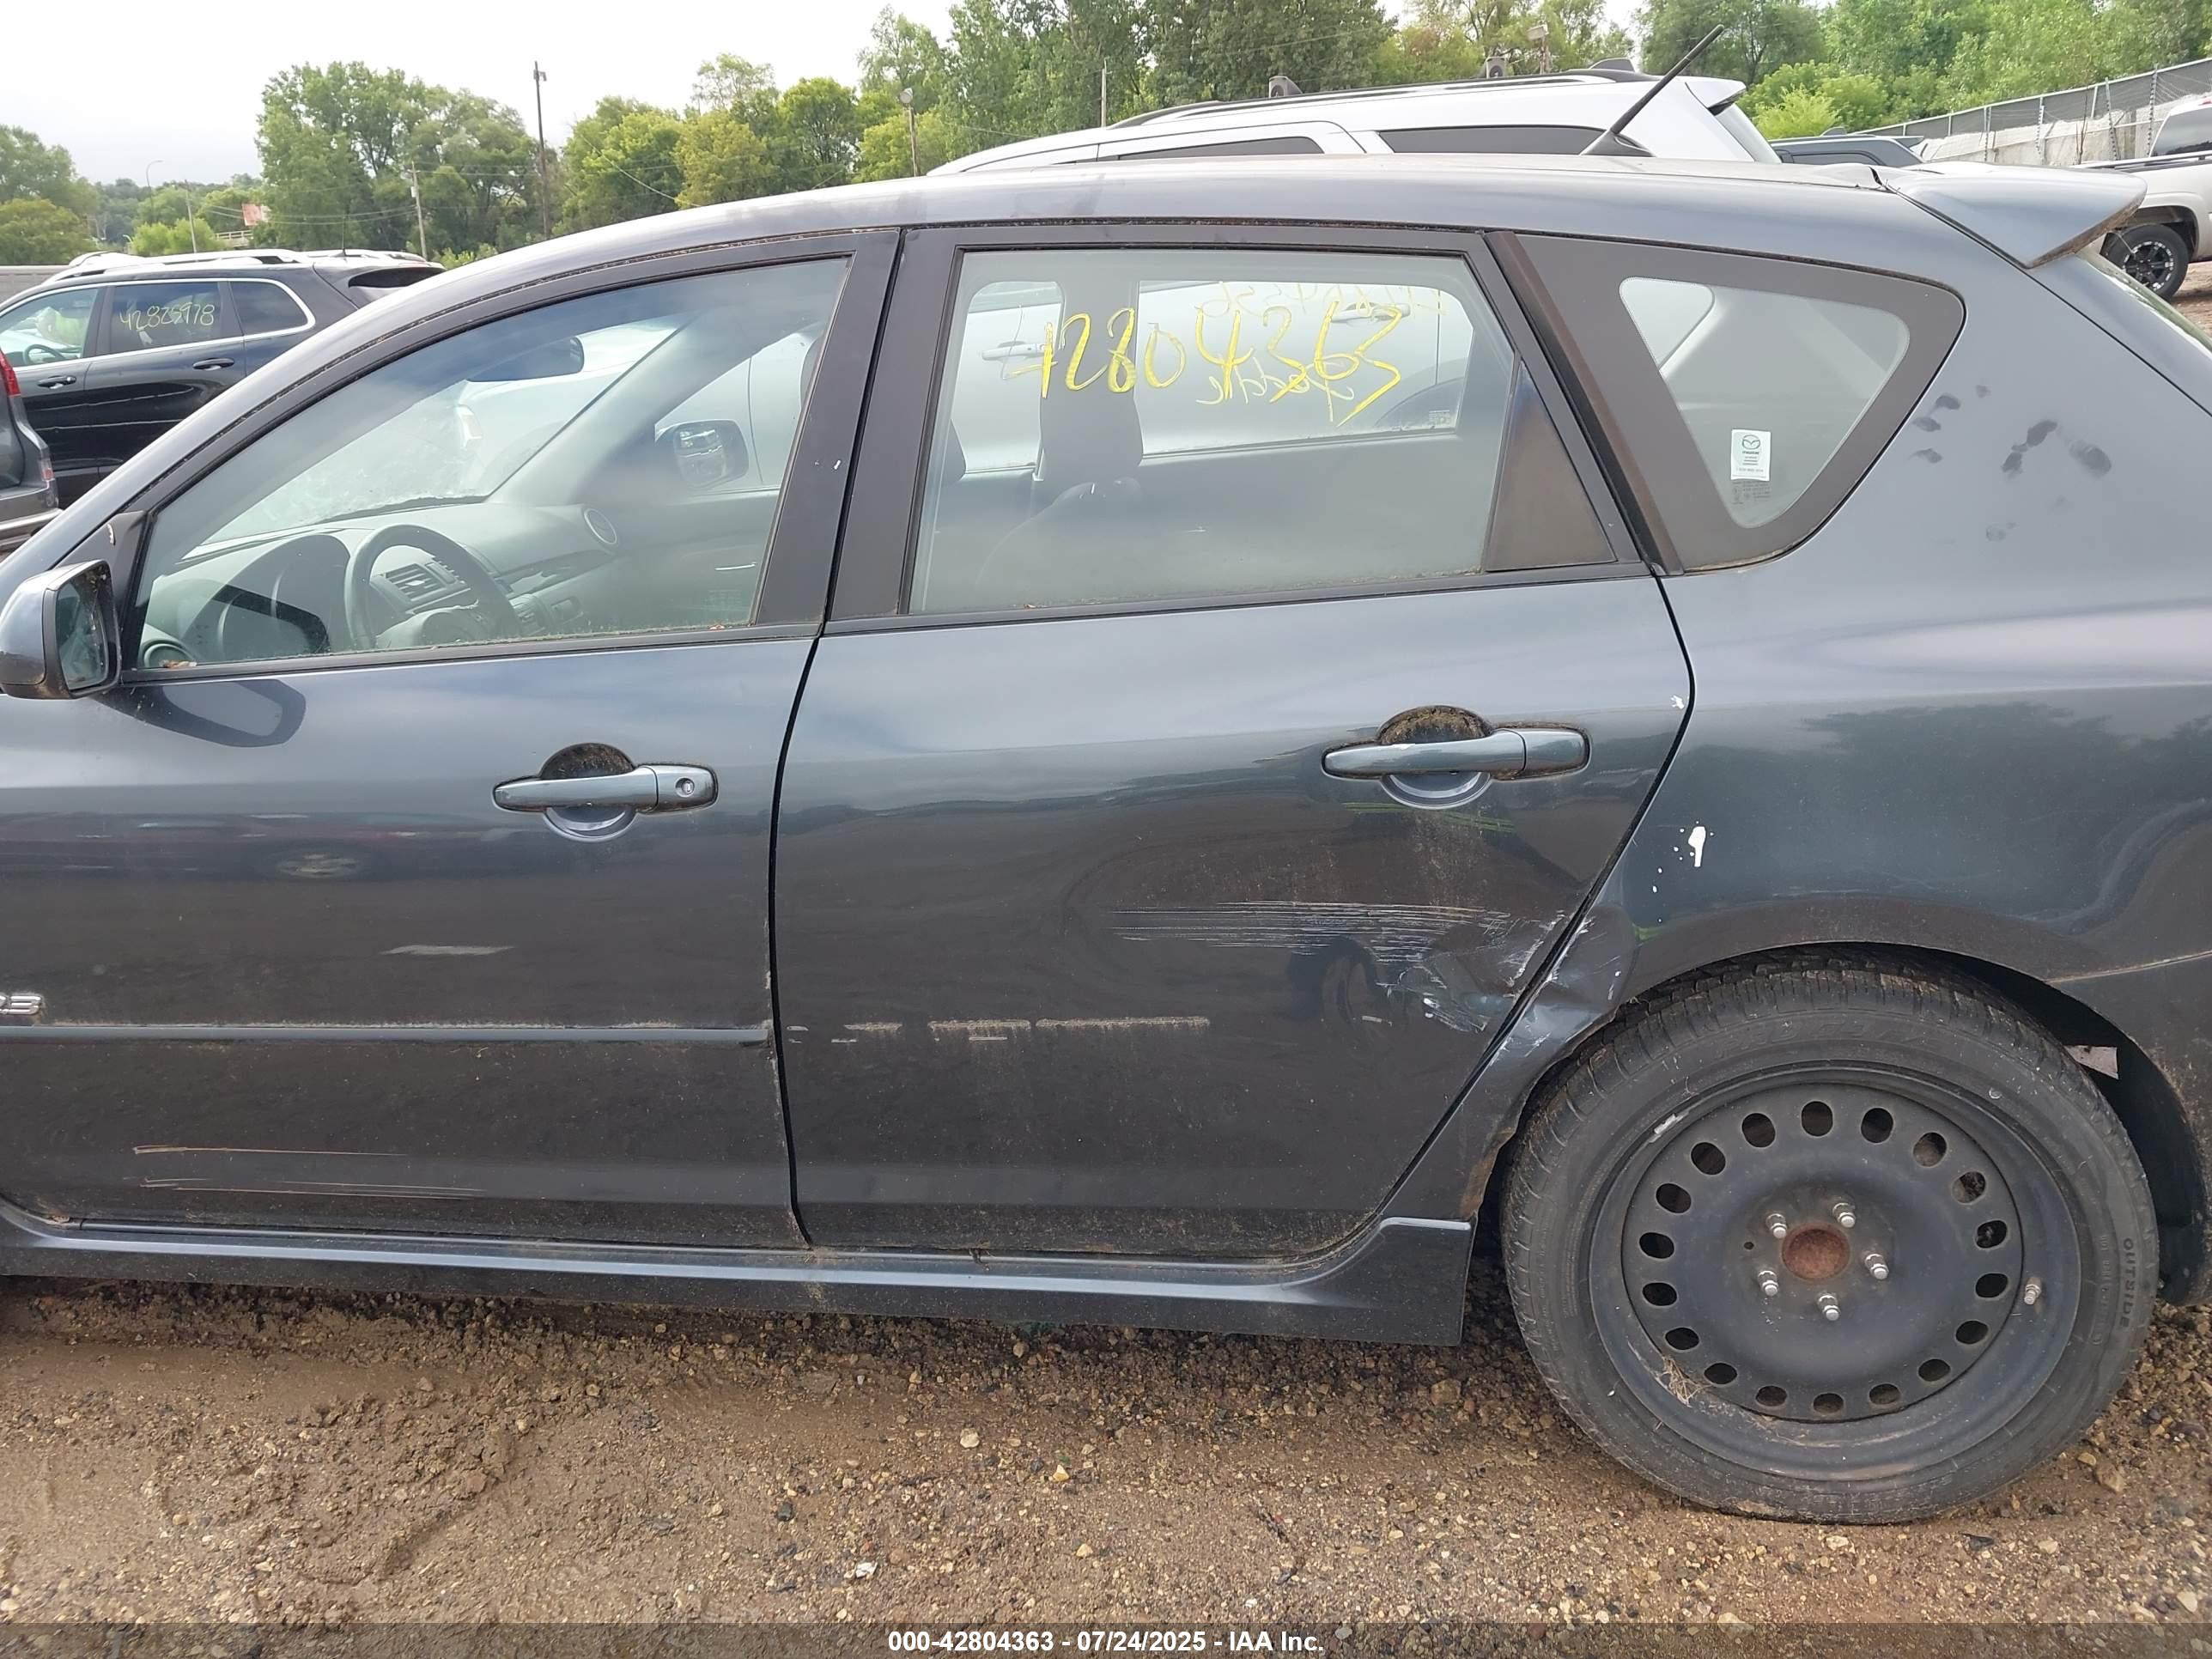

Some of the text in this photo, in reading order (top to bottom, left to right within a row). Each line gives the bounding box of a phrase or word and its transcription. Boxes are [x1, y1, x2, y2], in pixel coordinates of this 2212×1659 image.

[119, 303, 215, 331] 42825978
[1004, 301, 1401, 428] 42804363
[2119, 1237, 2137, 1328] OUTSIDE
